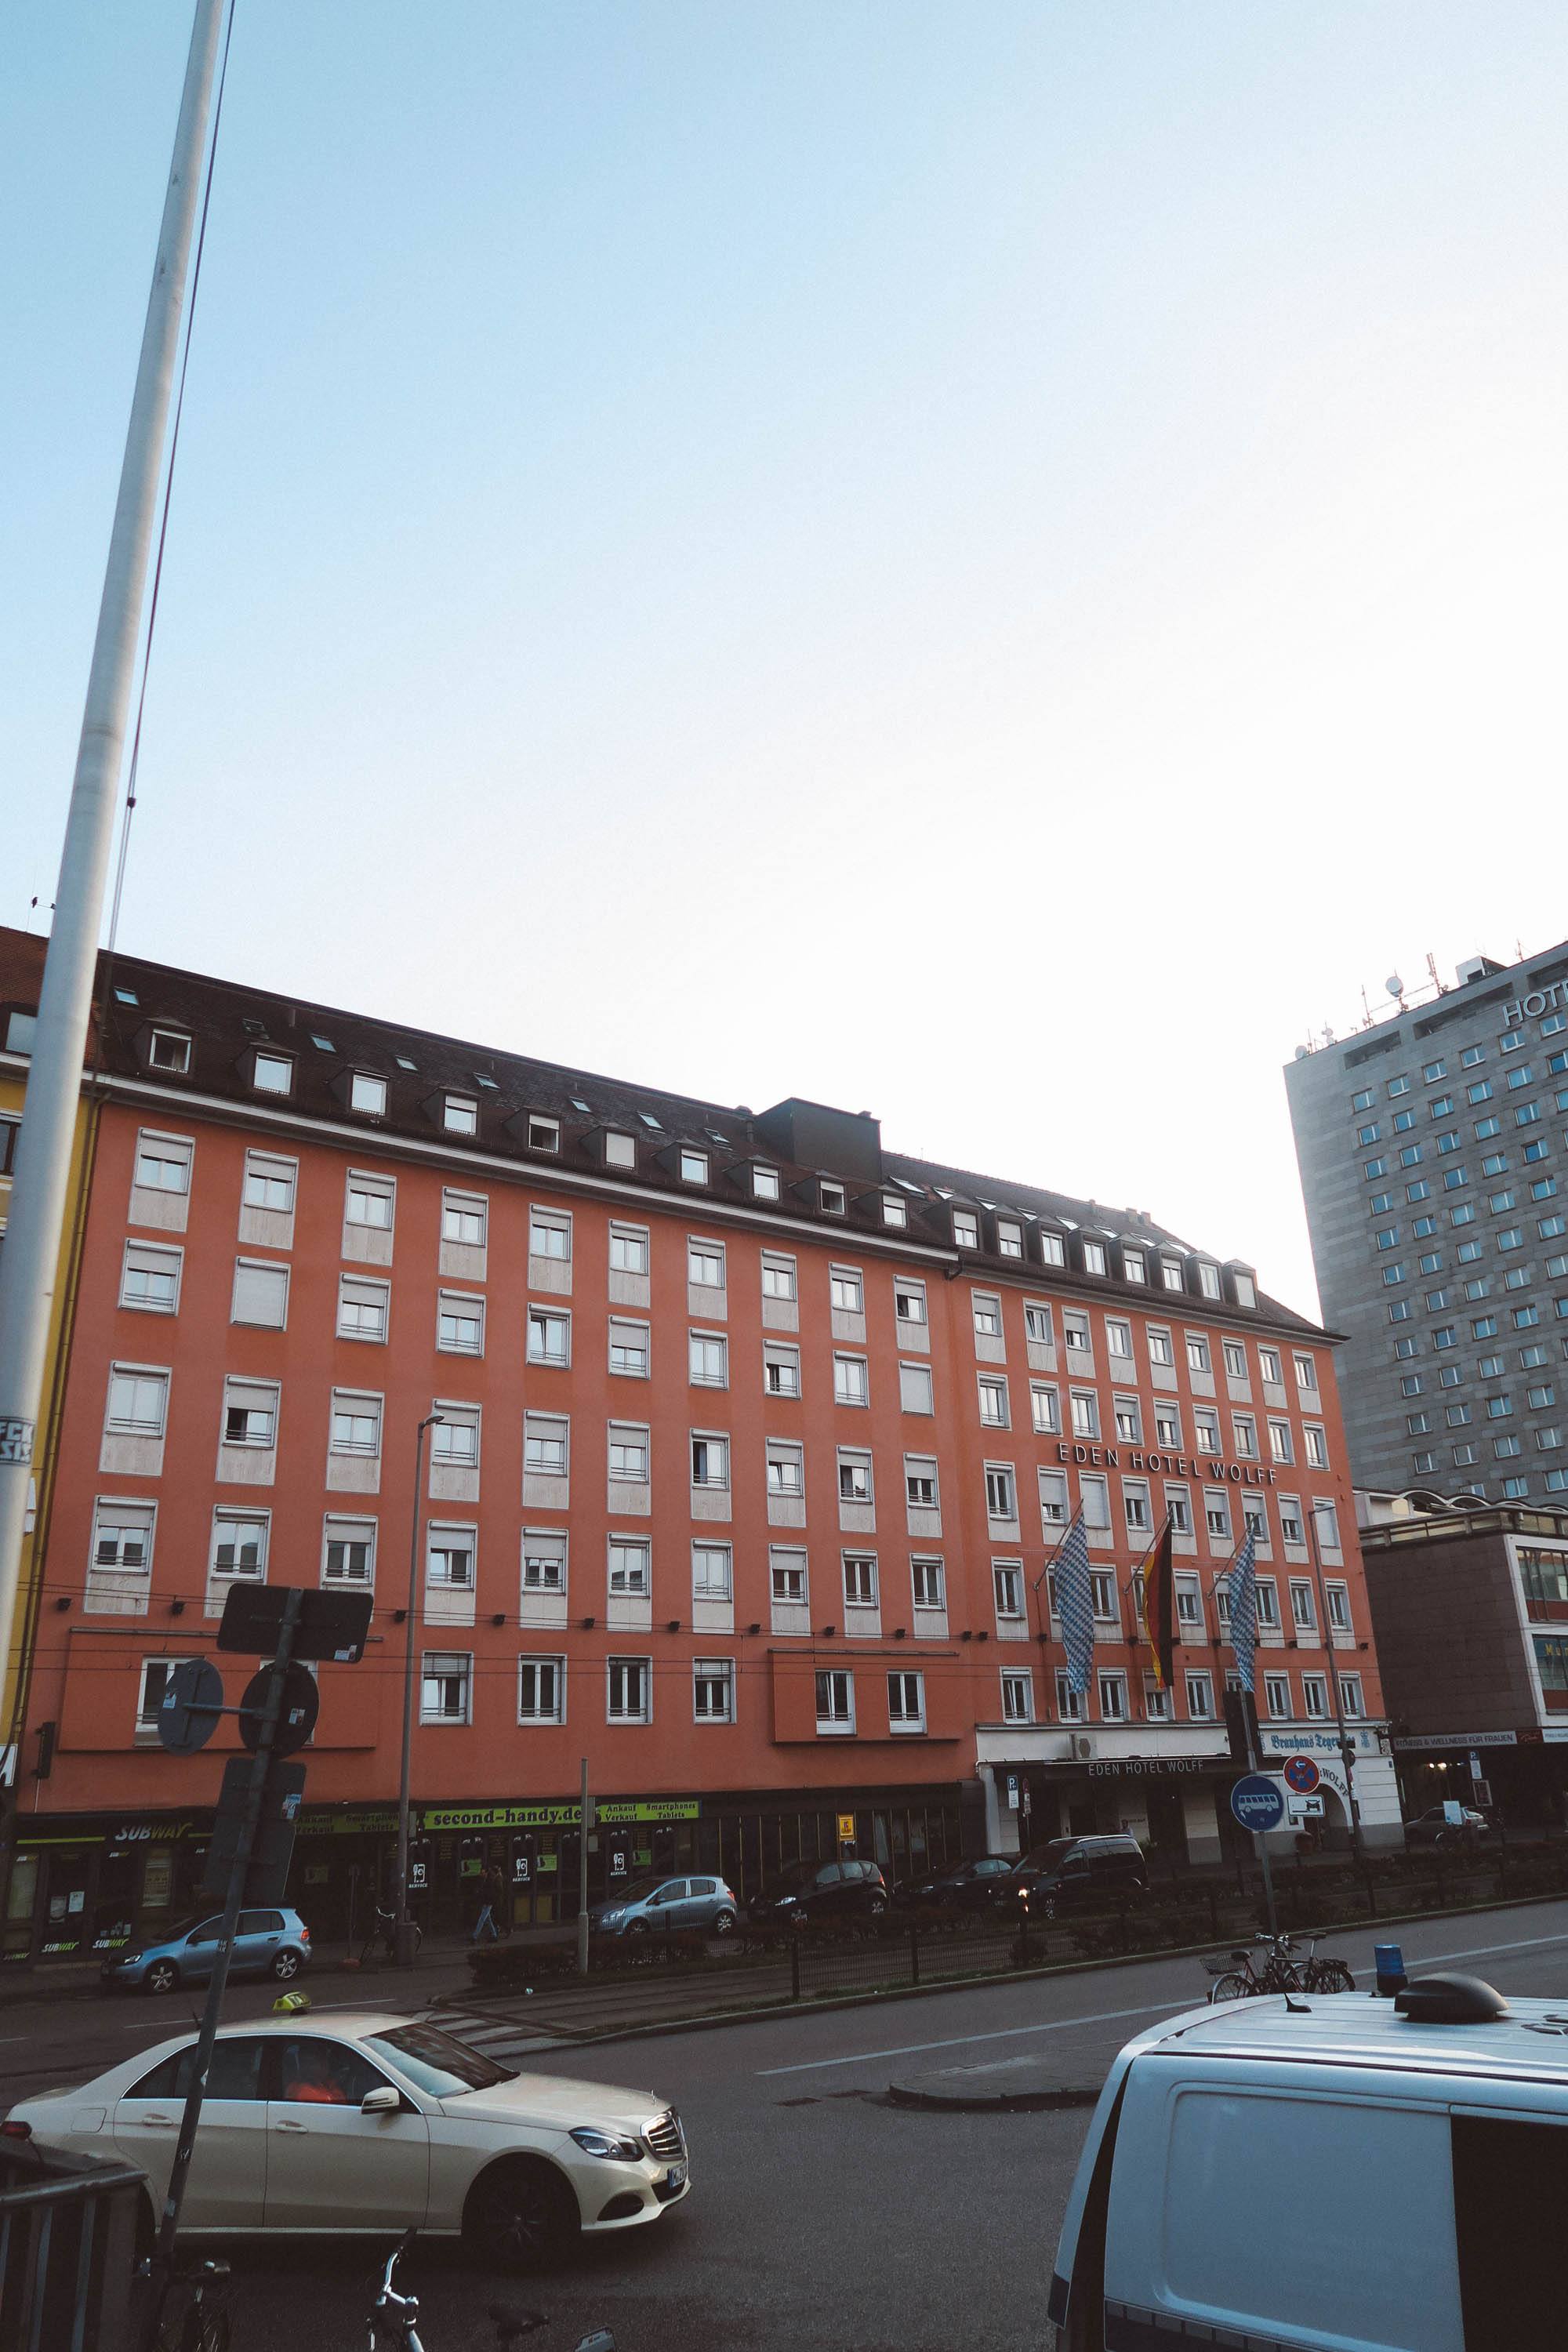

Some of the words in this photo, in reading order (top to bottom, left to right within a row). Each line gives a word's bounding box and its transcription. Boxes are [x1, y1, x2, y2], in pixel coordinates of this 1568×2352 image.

[1058, 1443, 1120, 1466] EDEN
[1132, 1451, 1203, 1477] HOTEL
[1211, 1461, 1277, 1485] WOLFF
[1271, 1734, 1314, 1751] Brauhaus
[1431, 1736, 1468, 1744] WELLNESS
[1469, 1734, 1482, 1743] FÜR
[1484, 1733, 1513, 1743] FRAUEN
[1089, 1765, 1120, 1776] EDEN
[1126, 1762, 1162, 1774] HOTEL
[1167, 1760, 1203, 1773] WOLFF
[1009, 1777, 1015, 1789] P
[646, 1802, 695, 1811] Smartphones
[434, 1807, 582, 1826] second-handy.de
[114, 1821, 194, 1842] SUBWAY
[42, 1940, 79, 1953] SUBWAY
[93, 1938, 129, 1949] SUBWAY
